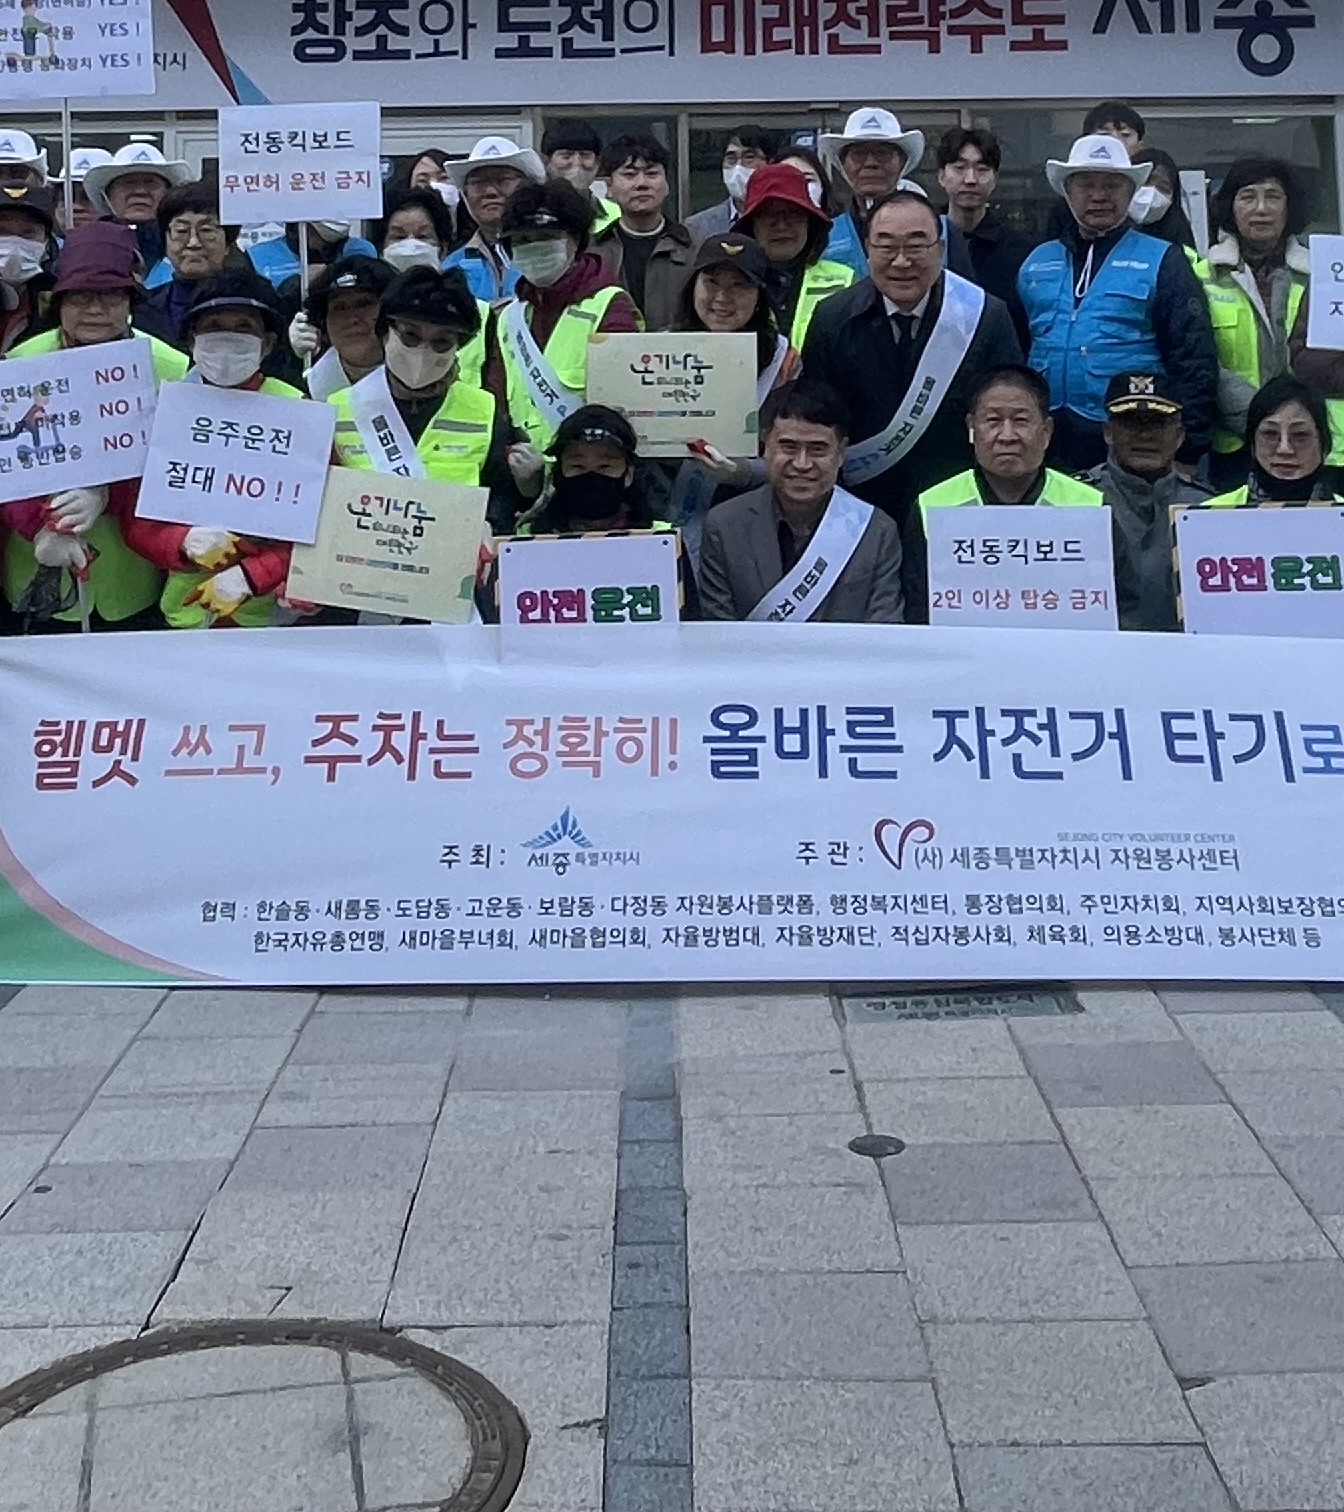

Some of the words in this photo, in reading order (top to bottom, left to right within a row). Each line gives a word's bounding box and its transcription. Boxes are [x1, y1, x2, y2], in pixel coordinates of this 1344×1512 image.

[98, 22, 129, 37] YES
[99, 52, 130, 68] YES
[239, 130, 356, 155] 전동킥보드
[222, 170, 281, 194] 무면허
[289, 170, 328, 192] 운전
[335, 170, 372, 190] 금지
[94, 366, 126, 385] NO
[99, 398, 130, 418] NO
[103, 432, 134, 452] NO
[189, 414, 293, 456] 음주운전
[164, 460, 217, 491] 절대
[224, 473, 267, 500] NO
[952, 537, 1086, 565] 전동킥보드
[932, 589, 963, 610] 2인
[971, 588, 1012, 611] 이상
[1020, 588, 1061, 612] 탑승
[1069, 588, 1110, 612] 금지
[31, 717, 146, 792] 헬멧
[161, 722, 283, 789] 쓰고,
[303, 710, 482, 784] 주차는
[503, 715, 680, 781] 정확히!
[701, 702, 904, 782] 올바른
[931, 705, 1135, 785] 자전거
[1193, 833, 1236, 844] CENTER
[914, 846, 944, 871] (사)
[950, 845, 1101, 871] 세종특별자치시
[1110, 845, 1242, 872] 자원봉사센터
[200, 899, 237, 923] 협력
[829, 892, 957, 917] 행정복지센터,
[964, 892, 1071, 917] 통장협의회,
[1079, 892, 1187, 917] 주민자치회,
[253, 929, 390, 954] 한국자유총연맹,
[398, 928, 519, 952] 새마을부녀회,
[528, 926, 652, 951] 새마을협의회,
[661, 924, 766, 948] 자율방범대,
[775, 924, 882, 948] 자율방재단,
[890, 924, 1017, 948] 적십자봉사회,
[1026, 924, 1094, 947] 체육회,
[1102, 925, 1212, 949] 의용소방대,
[1218, 925, 1297, 948] 봉사단체
[1302, 926, 1323, 949] 등
